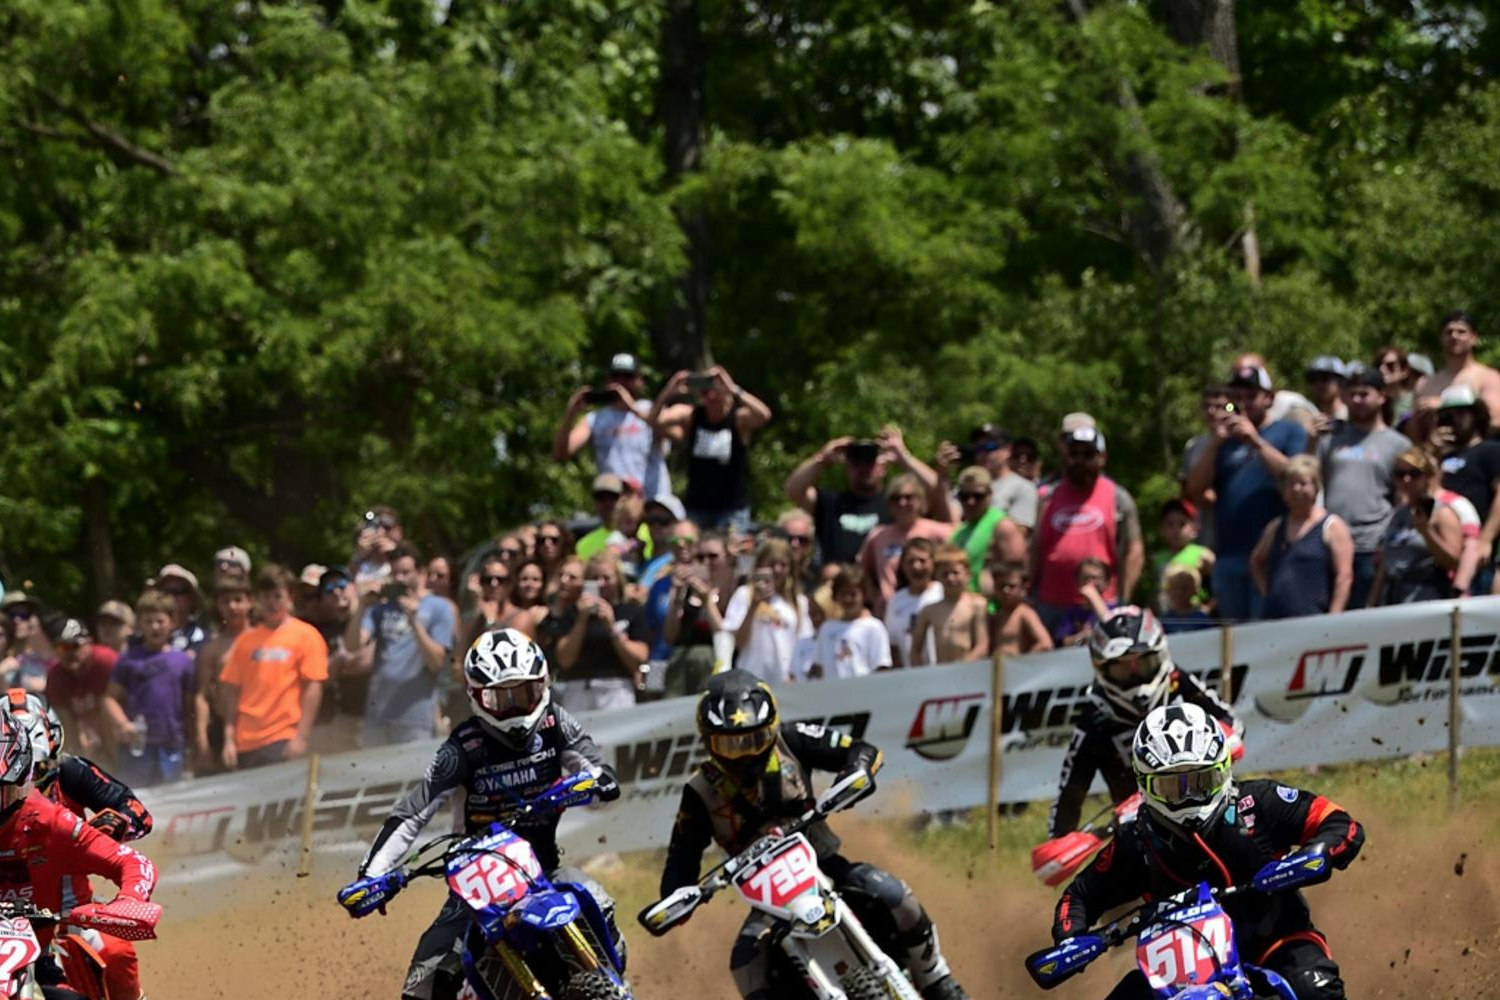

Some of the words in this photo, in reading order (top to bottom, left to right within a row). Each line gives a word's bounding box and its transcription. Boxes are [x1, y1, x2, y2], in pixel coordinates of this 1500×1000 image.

[486, 767, 538, 792] YAMAHA
[456, 839, 541, 911] 523
[749, 846, 815, 906] 739
[1146, 915, 1232, 990] 514
